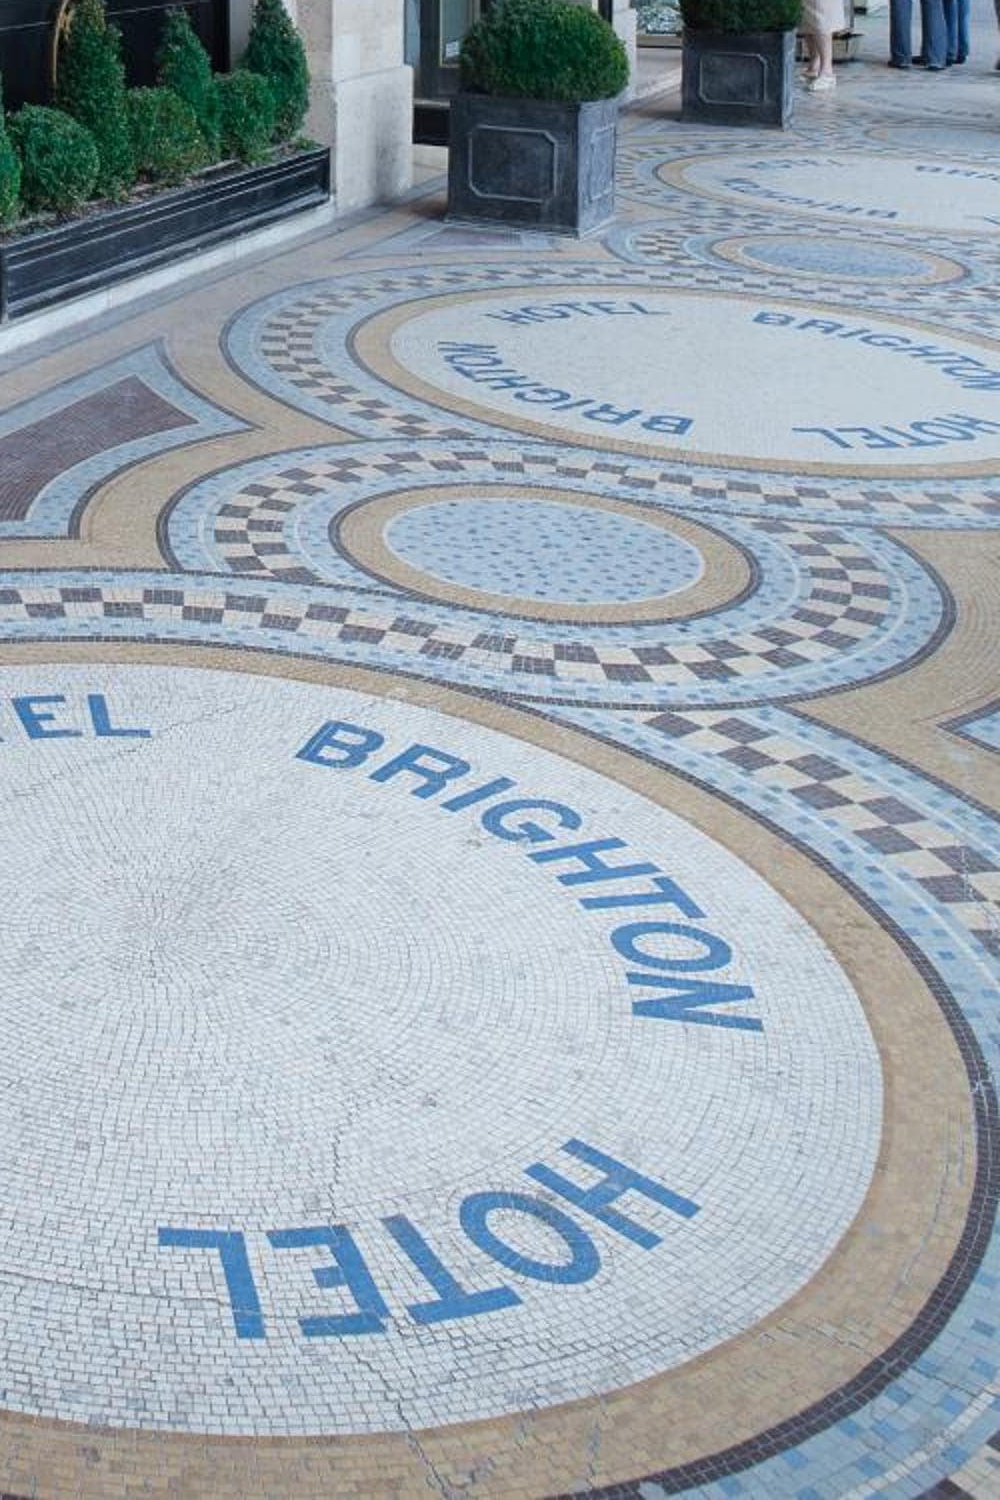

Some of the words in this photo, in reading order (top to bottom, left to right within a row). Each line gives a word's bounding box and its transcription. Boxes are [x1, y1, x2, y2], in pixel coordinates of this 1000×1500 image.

[437, 340, 694, 435] BRIGHTON
[484, 300, 672, 325] HOTEL
[752, 310, 1000, 391] BRIGHTON
[791, 412, 1000, 449] HOTEL
[293, 718, 764, 1033] BRIGHTON
[157, 1140, 702, 1341] HOTEL
